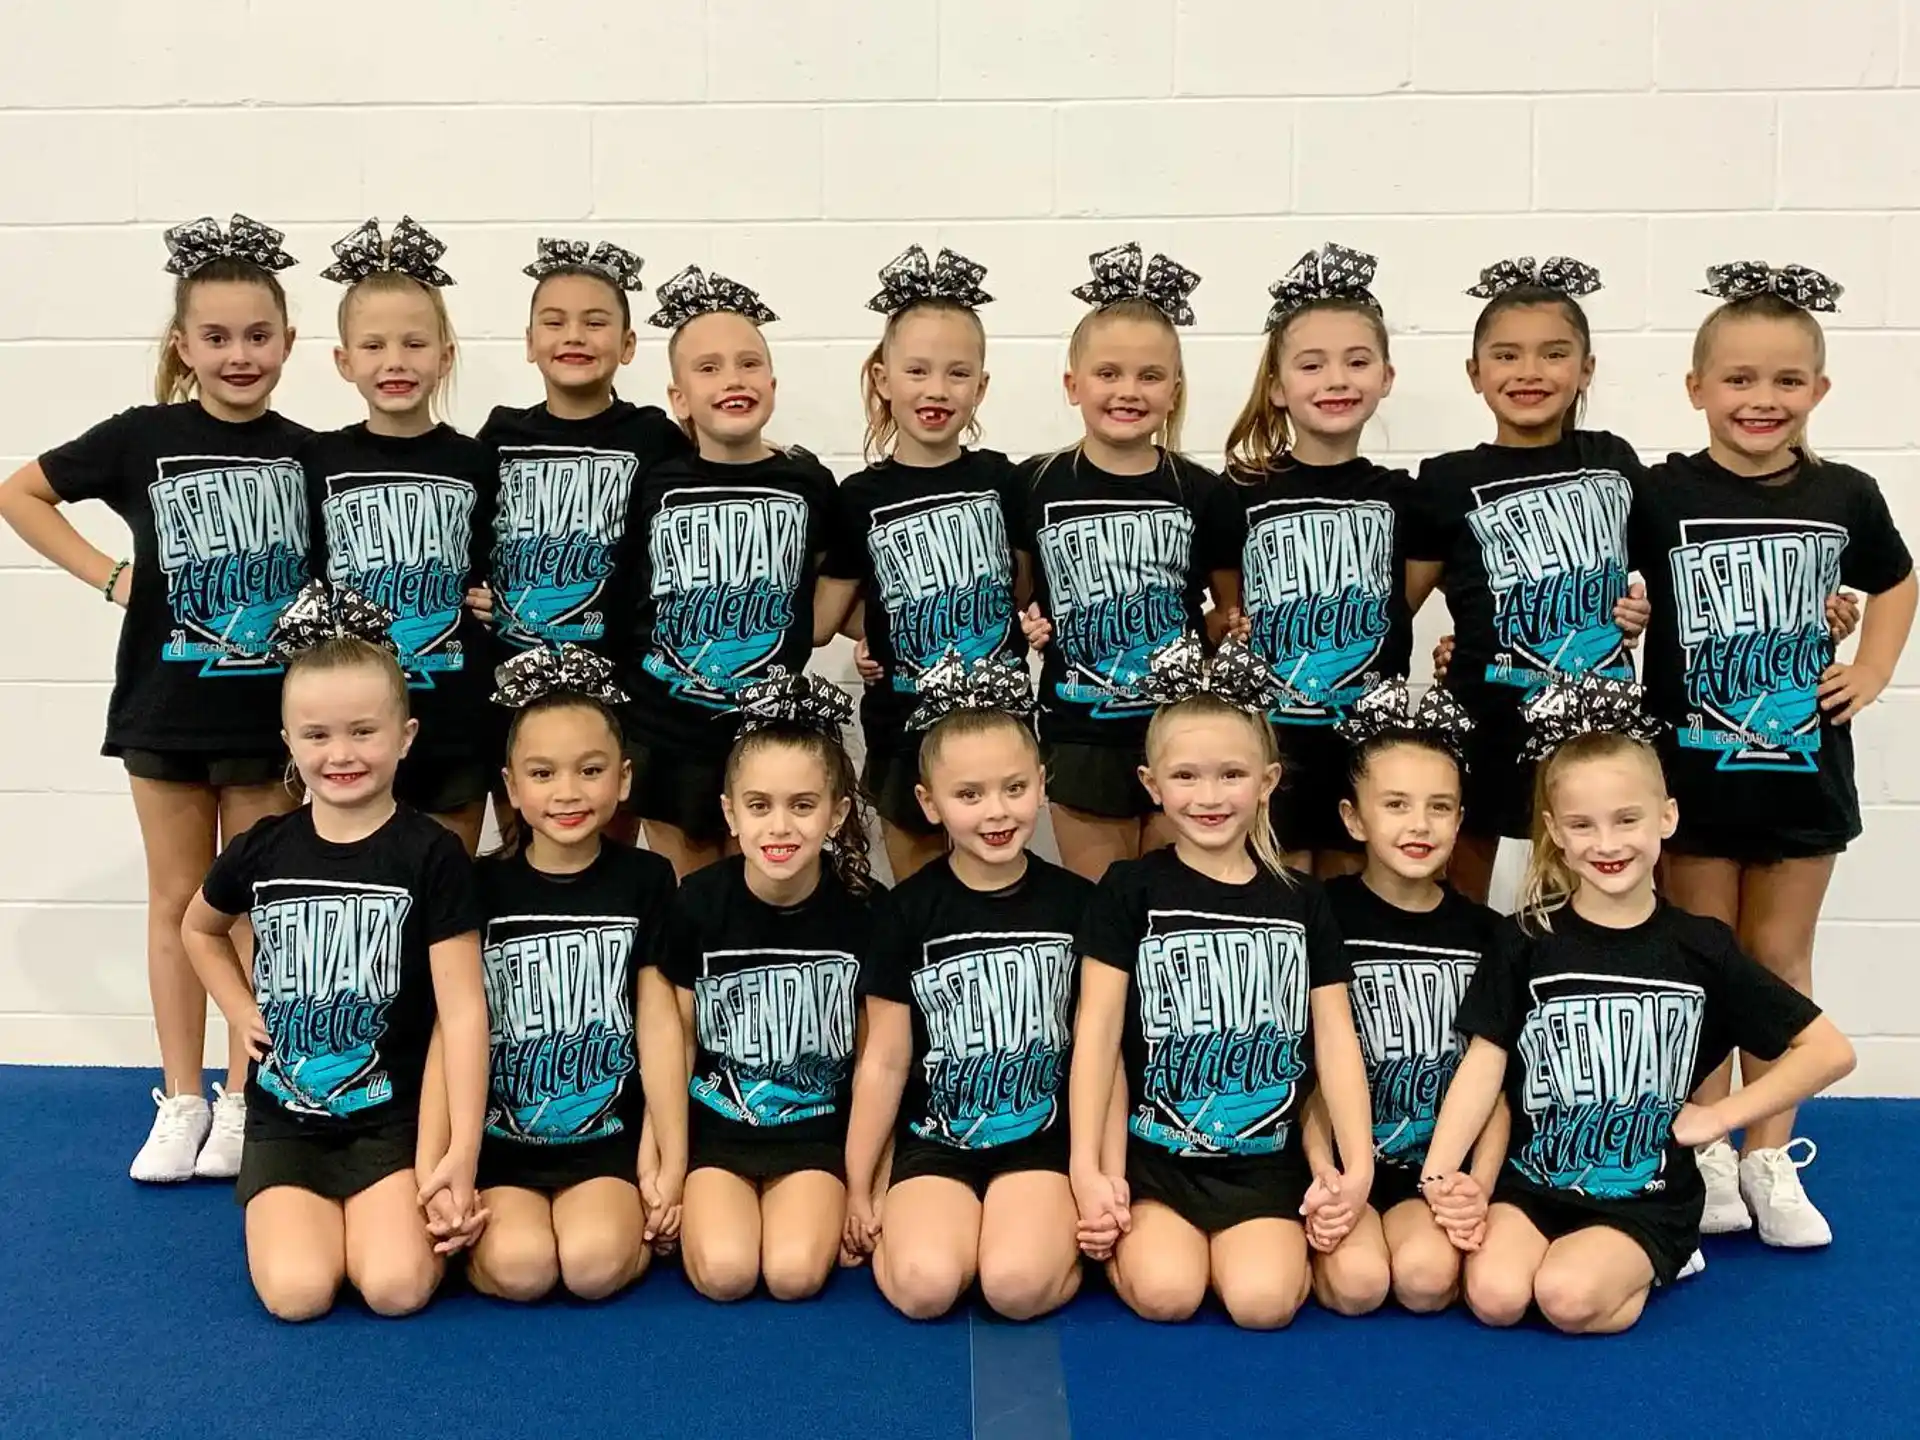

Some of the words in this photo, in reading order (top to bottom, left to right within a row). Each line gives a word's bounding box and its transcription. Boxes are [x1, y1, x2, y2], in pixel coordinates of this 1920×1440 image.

[496, 456, 639, 546] EGENDARY
[333, 556, 469, 620] thletics
[498, 530, 617, 592] thletics
[1494, 555, 1628, 648] Athleti
[1668, 531, 1848, 649] LEGENDAR
[652, 576, 795, 650] Athletics
[1251, 584, 1391, 667] Athletics
[1684, 622, 1836, 708] Athletic
[1687, 713, 1702, 743] 21
[262, 989, 395, 1065] thletics
[694, 958, 860, 1066] LEGENDARY
[1136, 927, 1309, 1043] LEGENDARY
[1351, 960, 1481, 1066] GENDA
[490, 1021, 636, 1111] Athletics
[1144, 1022, 1306, 1104] Athletics
[1517, 992, 1705, 1115] LEGENDARY
[1136, 1104, 1155, 1136] 21
[1522, 1091, 1678, 1176] Athletic
